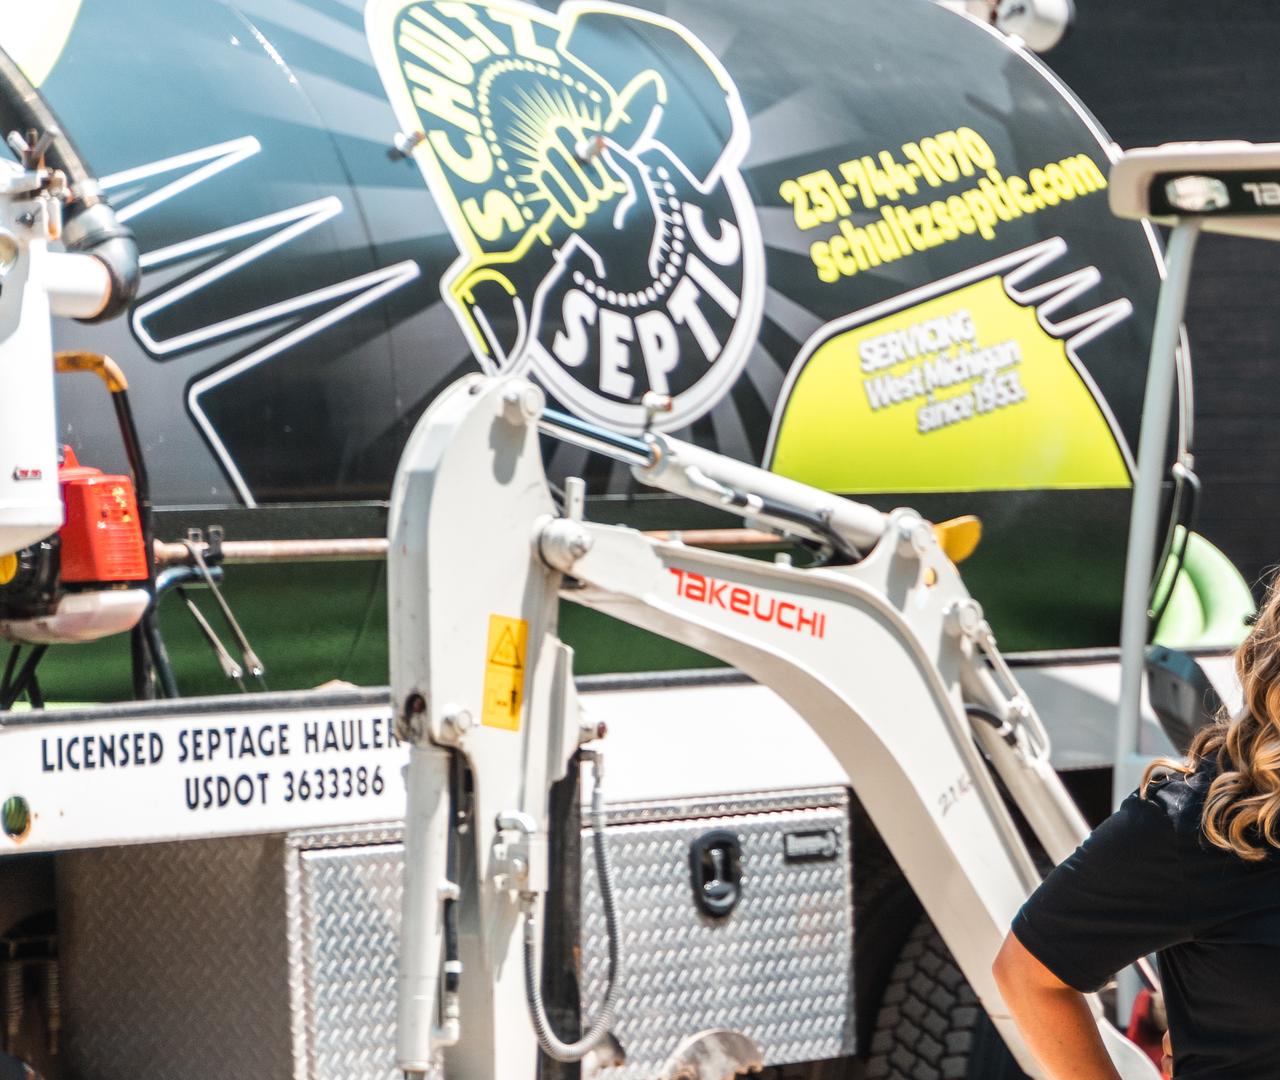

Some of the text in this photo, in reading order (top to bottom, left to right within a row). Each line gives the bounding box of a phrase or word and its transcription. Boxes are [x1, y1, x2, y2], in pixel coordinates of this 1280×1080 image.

[398, 2, 561, 241] SCHULTZ
[779, 126, 997, 231] 231-744-1070
[810, 153, 1107, 283] schultzseptic.com
[552, 202, 741, 399] SEPTIC
[859, 308, 975, 373] SERVICING
[863, 339, 1021, 411] West Michigan
[917, 393, 975, 434] since
[42, 732, 163, 772] LICENSED
[178, 723, 290, 762] SEPTAGE
[186, 765, 385, 811] USDOT 3633386
